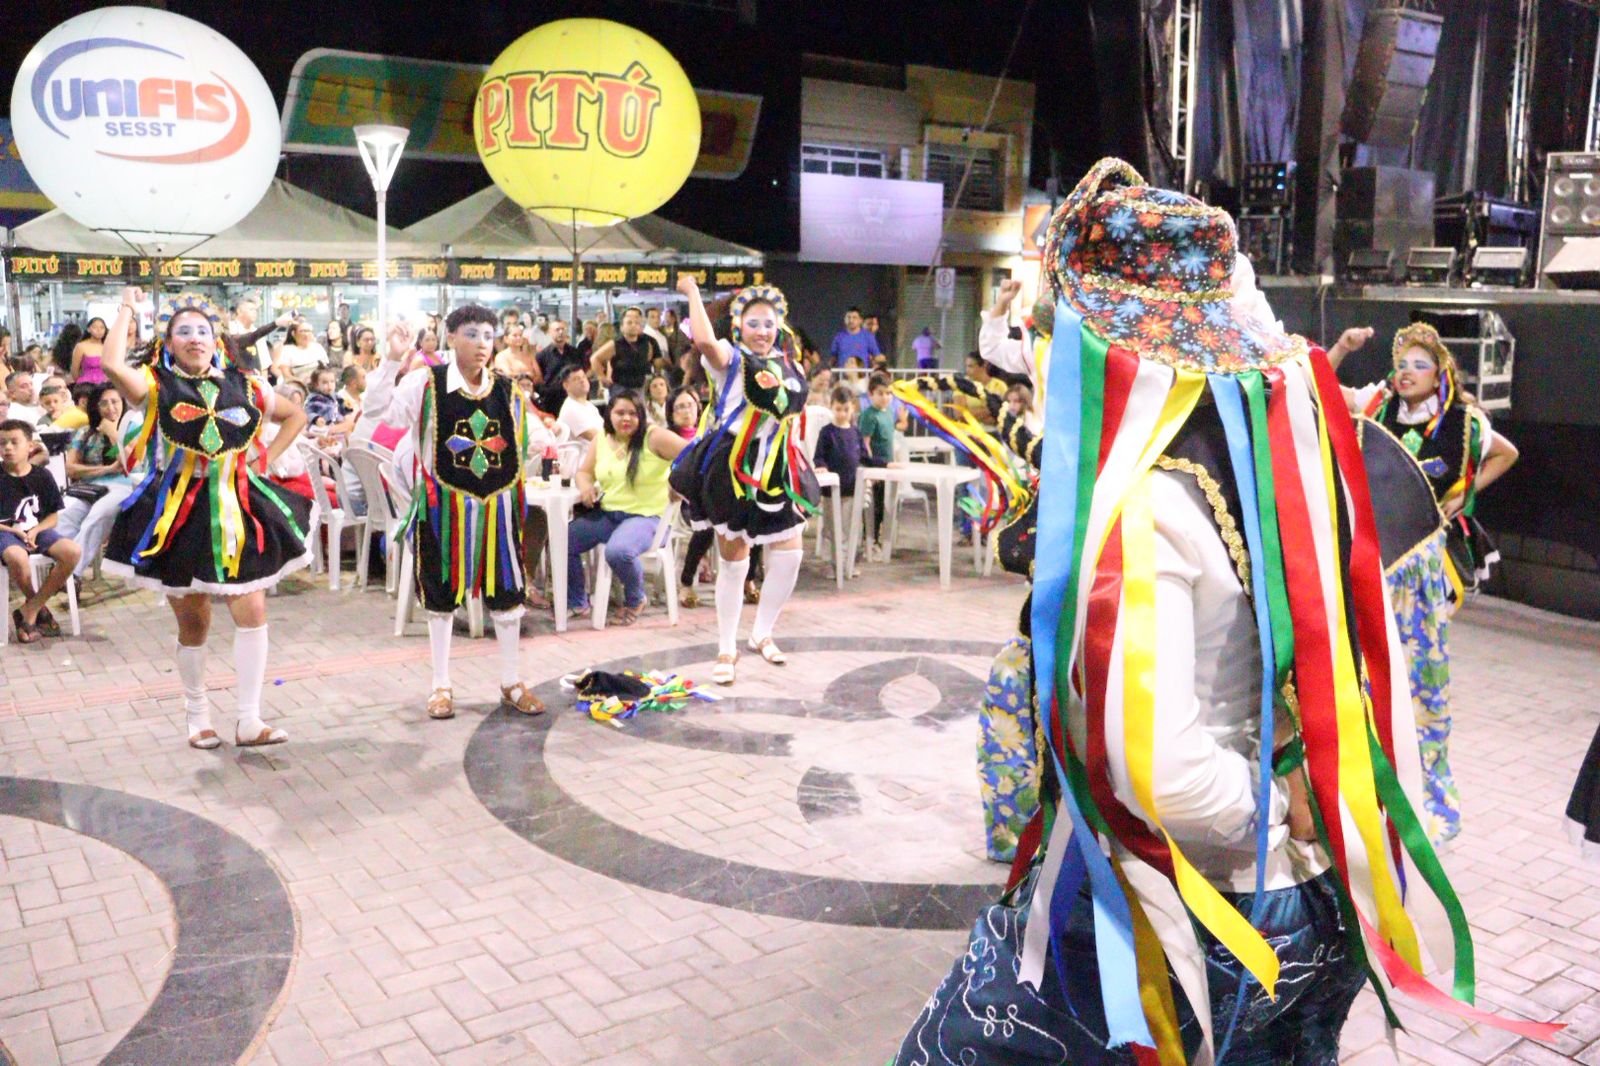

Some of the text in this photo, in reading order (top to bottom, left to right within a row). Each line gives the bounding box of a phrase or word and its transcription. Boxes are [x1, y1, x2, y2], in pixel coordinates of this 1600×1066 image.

[480, 60, 661, 158] PITÚ
[105, 121, 176, 137] SESST
[11, 255, 60, 274] PITÚ
[77, 256, 123, 275] PITÚ
[199, 259, 241, 277] PITÚ
[255, 259, 295, 277] PITÚ
[309, 260, 348, 278] PITÚ
